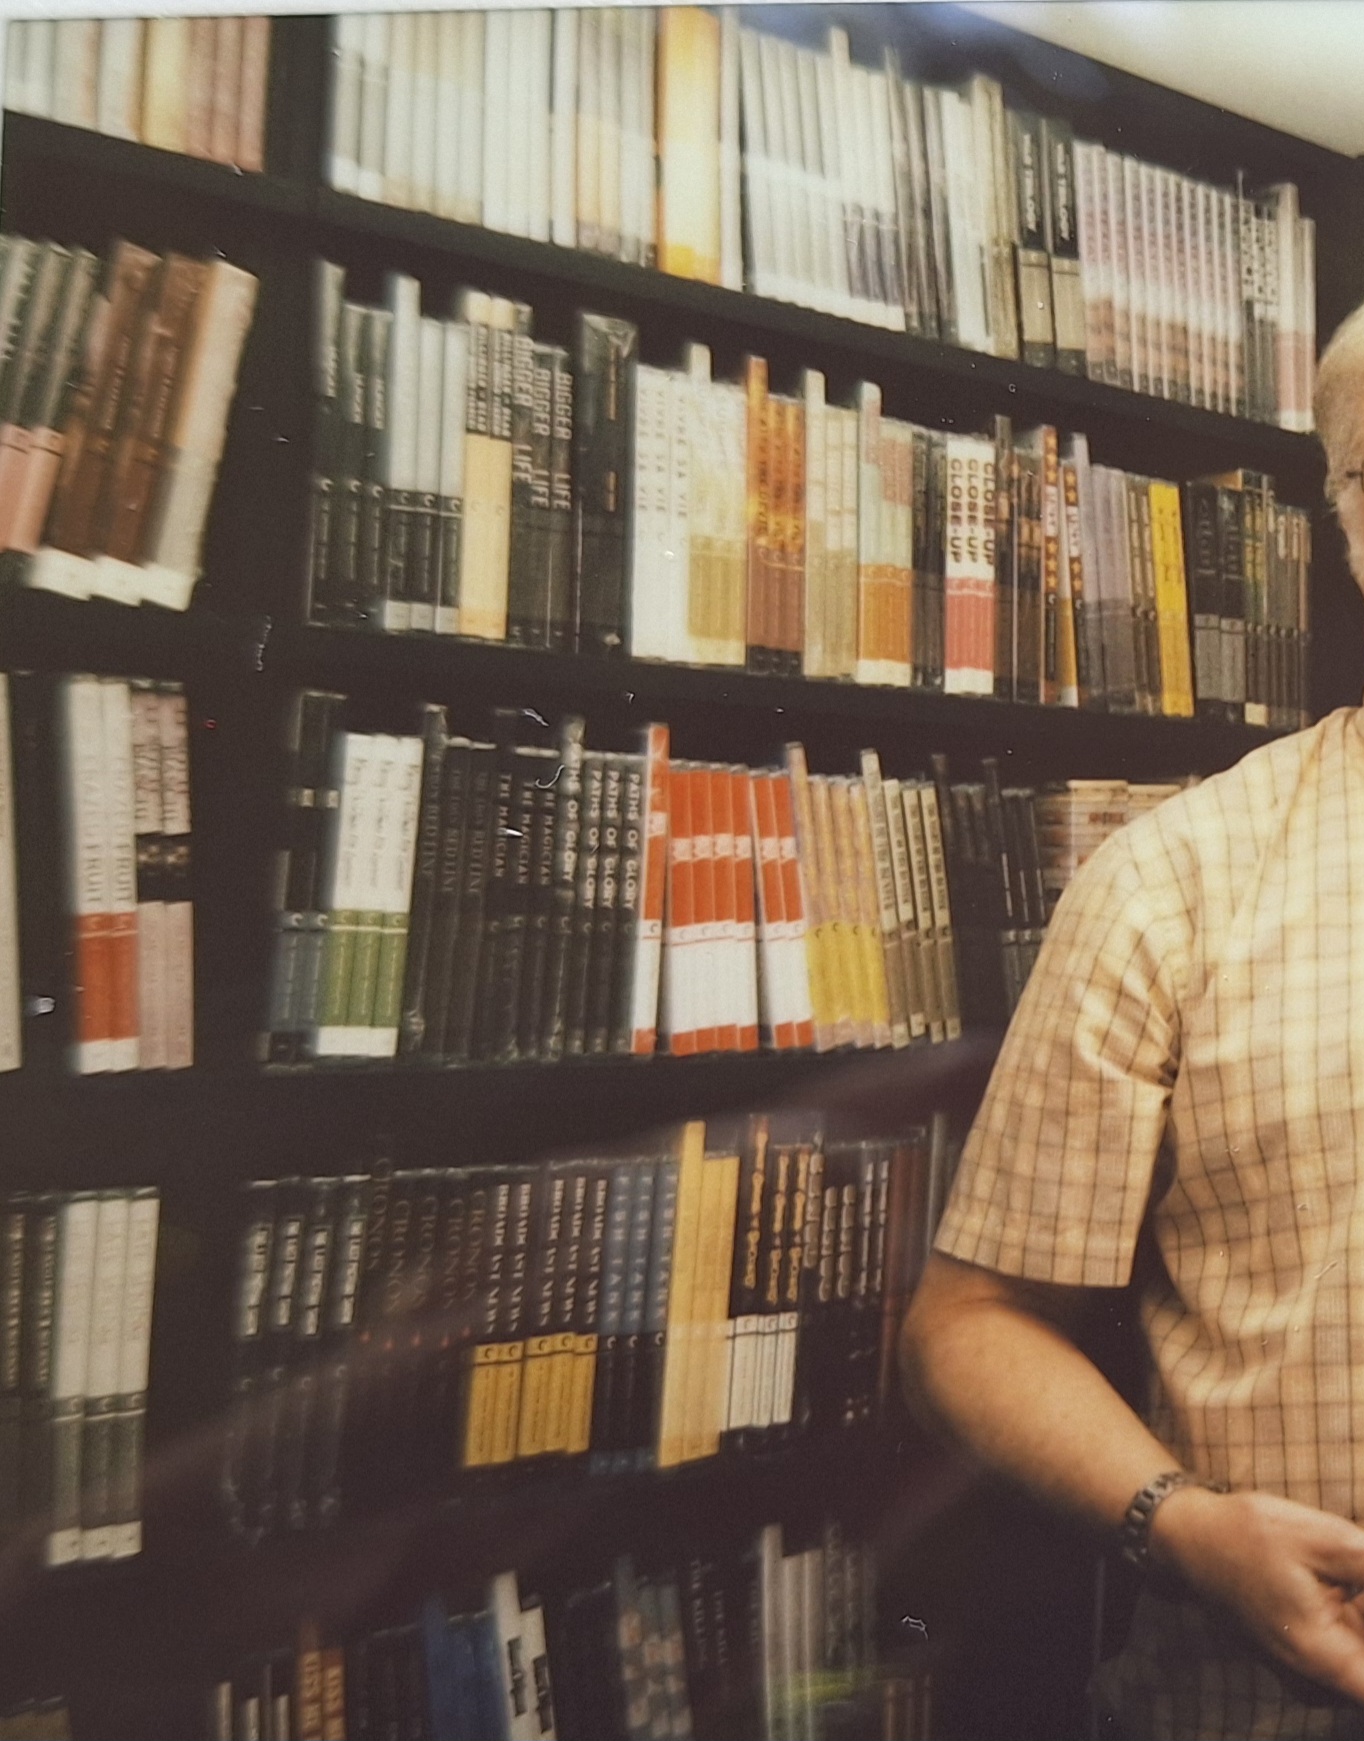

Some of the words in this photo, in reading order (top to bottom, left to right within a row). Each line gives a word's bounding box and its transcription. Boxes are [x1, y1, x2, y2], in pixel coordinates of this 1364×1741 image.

[514, 334, 534, 408] BIGGER
[533, 367, 552, 437] BIGGER
[554, 371, 573, 441] BIGGER
[512, 443, 533, 483] LIFE
[531, 468, 550, 509] LIFE
[553, 472, 572, 511] LIFE
[950, 458, 963, 564] CLOSE-UP
[967, 458, 979, 564] CLOSE-UP
[983, 461, 997, 567] CLOSE-UP
[499, 773, 512, 799] THE
[522, 782, 534, 807] THE
[567, 799, 579, 821] OF
[589, 770, 602, 819] PATHS
[606, 769, 620, 819] PATHS
[627, 773, 641, 821] PATHS
[518, 813, 532, 886] MAGICIAN
[540, 814, 555, 887] MAGICIAN
[563, 829, 578, 882] GLORY
[588, 826, 601, 849] OF
[606, 827, 619, 849] OF
[626, 829, 639, 850] OF
[584, 857, 598, 910] GLORY
[601, 857, 617, 910] GLORY
[623, 859, 639, 910] GLORY
